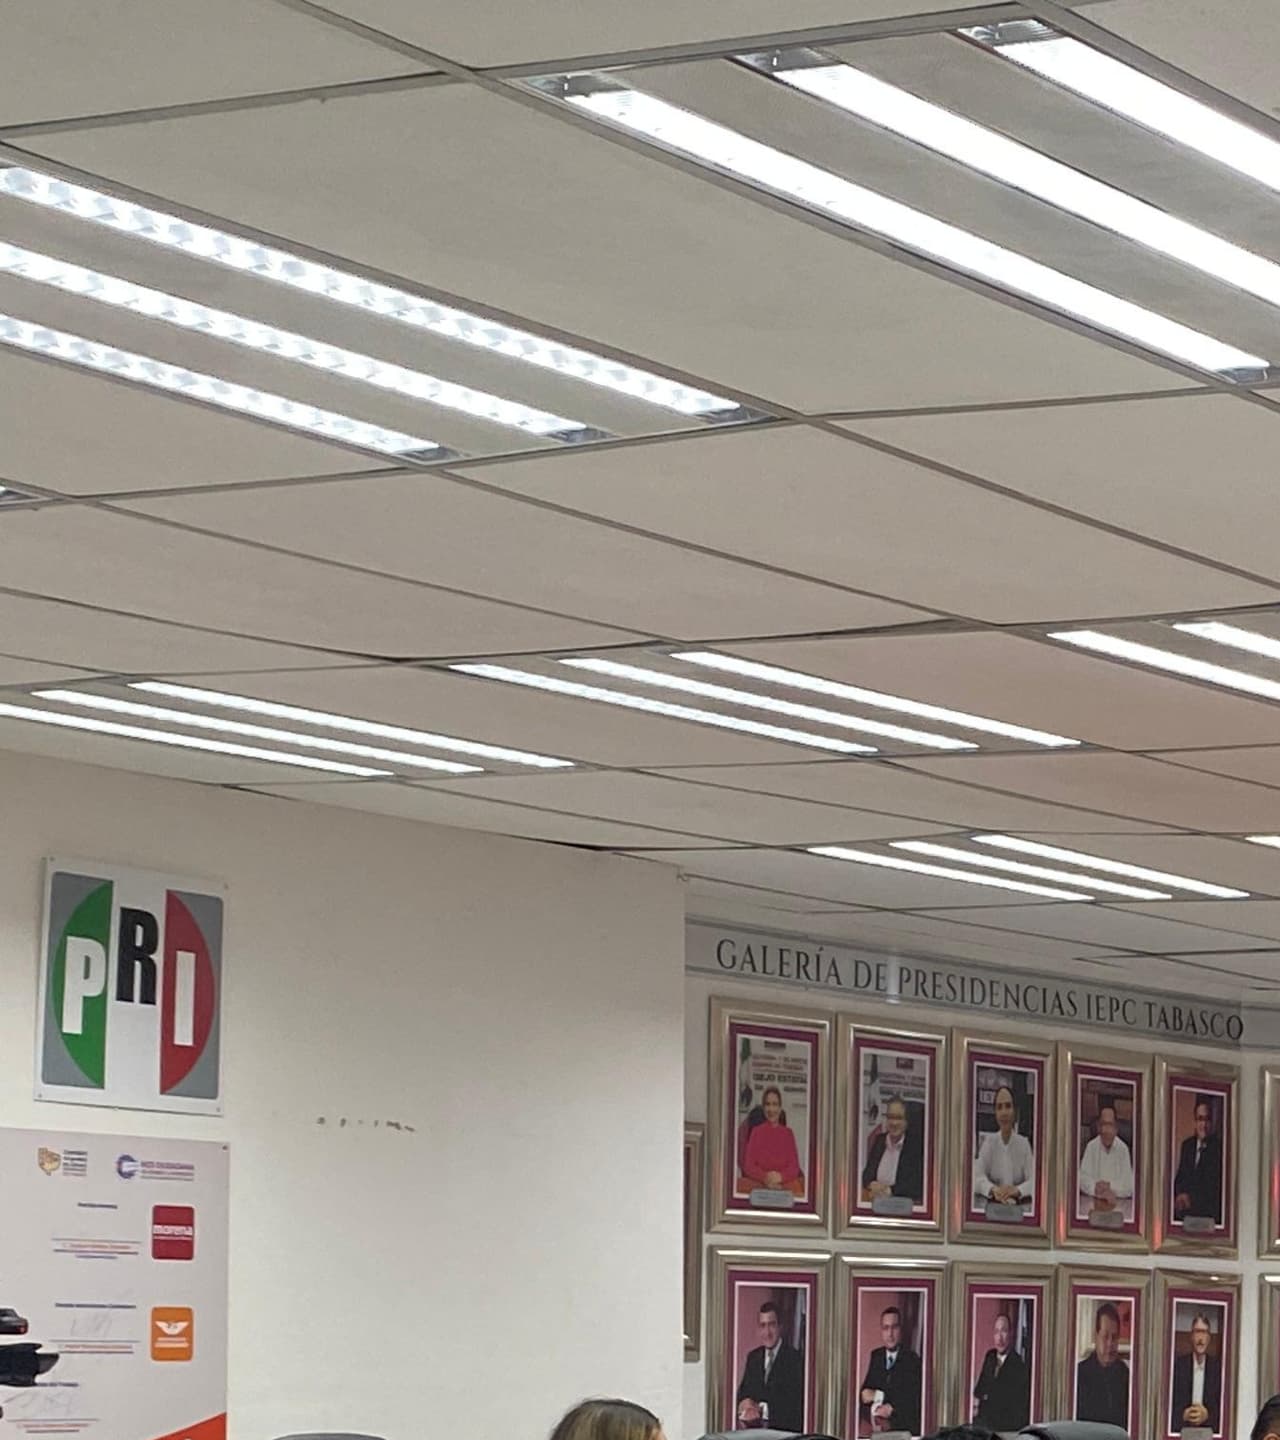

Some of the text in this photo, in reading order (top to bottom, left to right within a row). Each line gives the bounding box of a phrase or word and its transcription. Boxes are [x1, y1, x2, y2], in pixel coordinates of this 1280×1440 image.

[62, 907, 195, 1047] PRI
[716, 938, 1244, 1041] GALERÍA DE PRESIDENCIAS IEPC TABASCO
